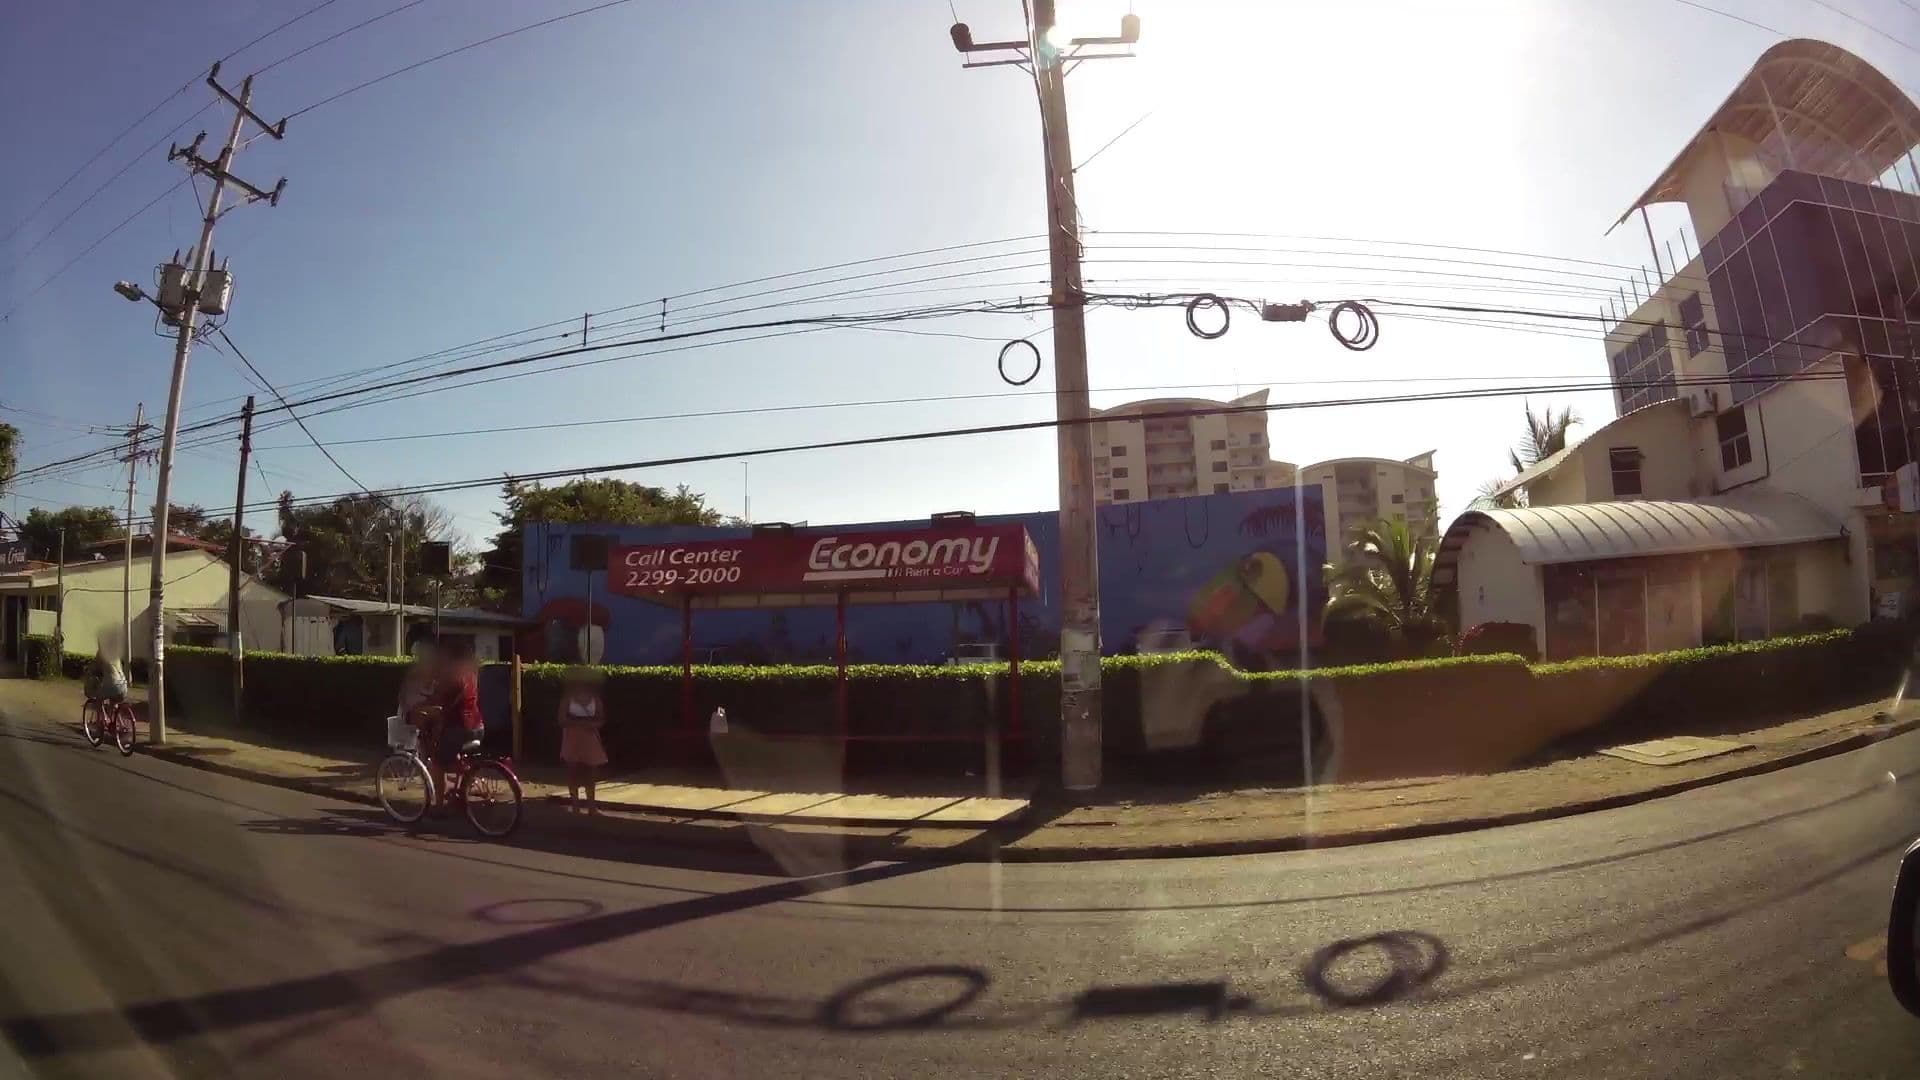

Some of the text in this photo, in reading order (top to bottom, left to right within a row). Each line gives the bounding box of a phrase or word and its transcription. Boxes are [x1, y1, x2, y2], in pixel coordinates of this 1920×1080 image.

[625, 549, 742, 566] Call Center
[808, 537, 999, 573] Economy
[625, 567, 741, 587] 2299-2000
[905, 568, 930, 577] Rent
